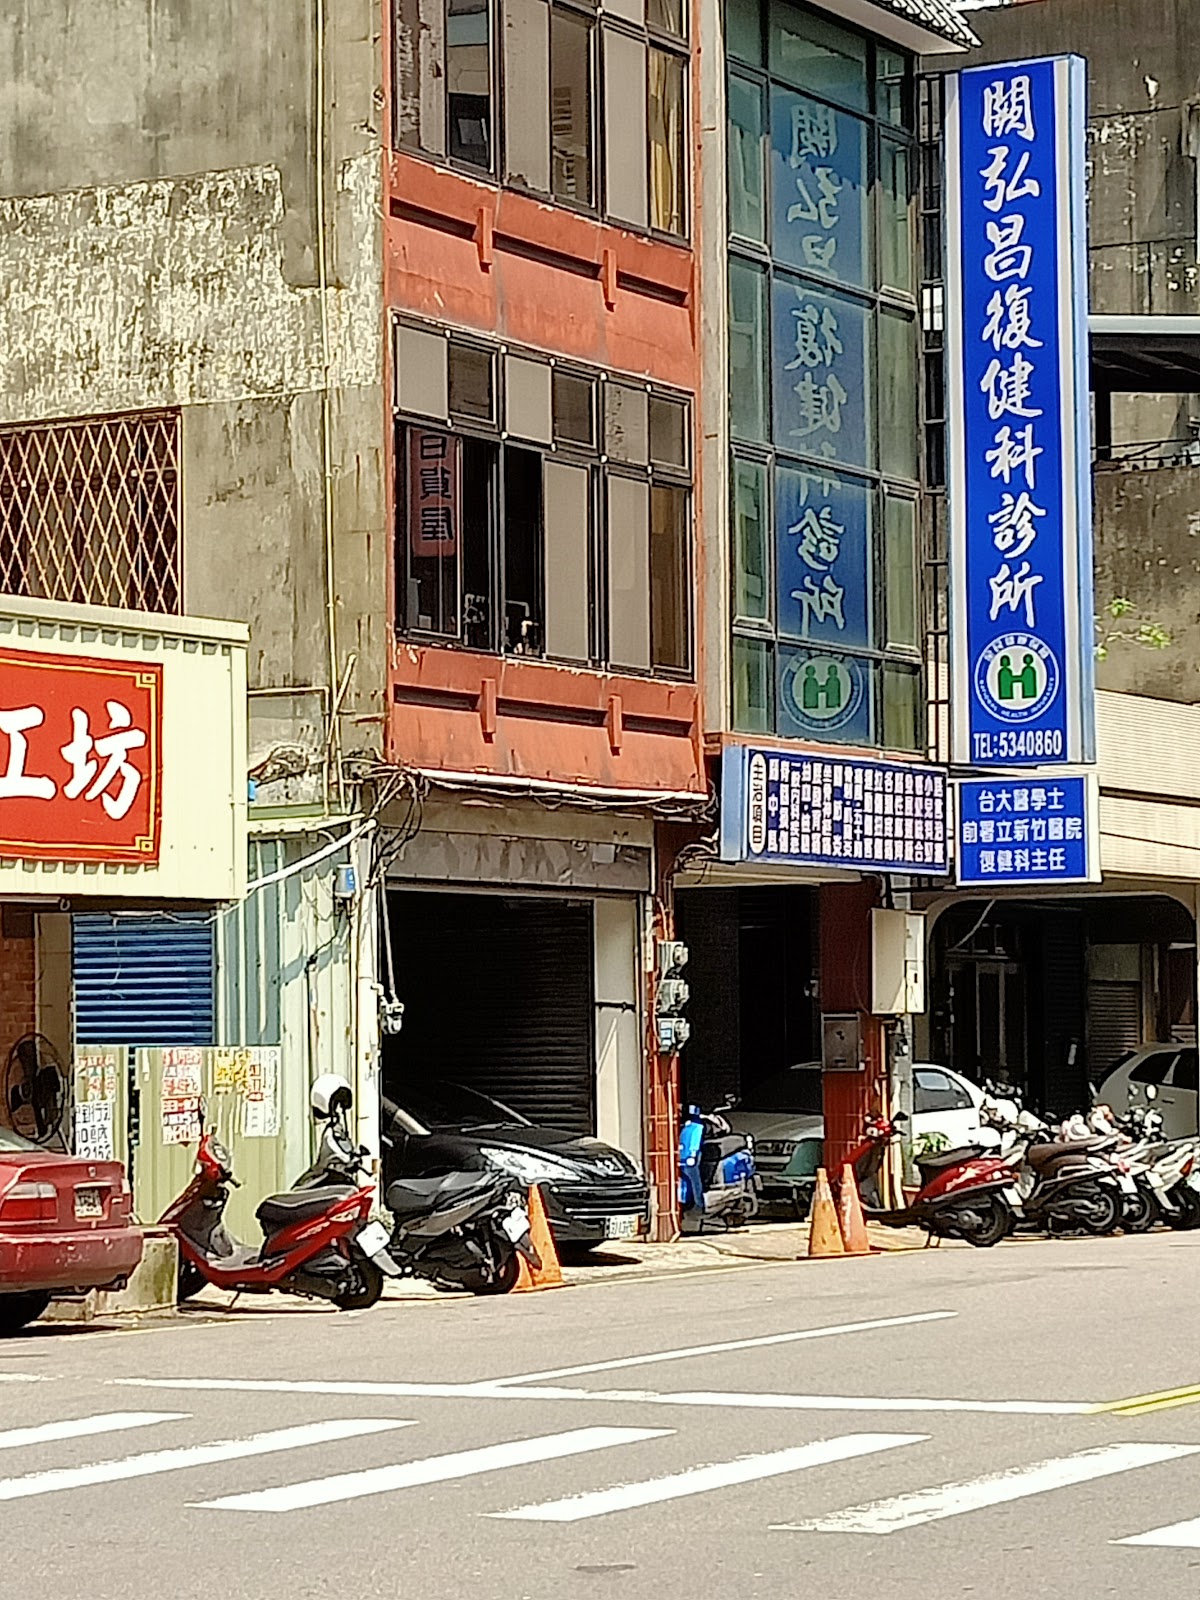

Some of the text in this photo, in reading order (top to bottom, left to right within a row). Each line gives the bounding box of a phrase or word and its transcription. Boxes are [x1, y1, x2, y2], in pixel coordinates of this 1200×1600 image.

[980, 75, 1046, 628] 闕弘昌復健科診所
[973, 730, 1062, 758] TEL:5340860
[0, 700, 147, 820] 工坊
[979, 787, 1064, 812] 台大醫學士
[962, 817, 1082, 843] 前署立新竹醫院
[979, 848, 1066, 873] 復健科主任
